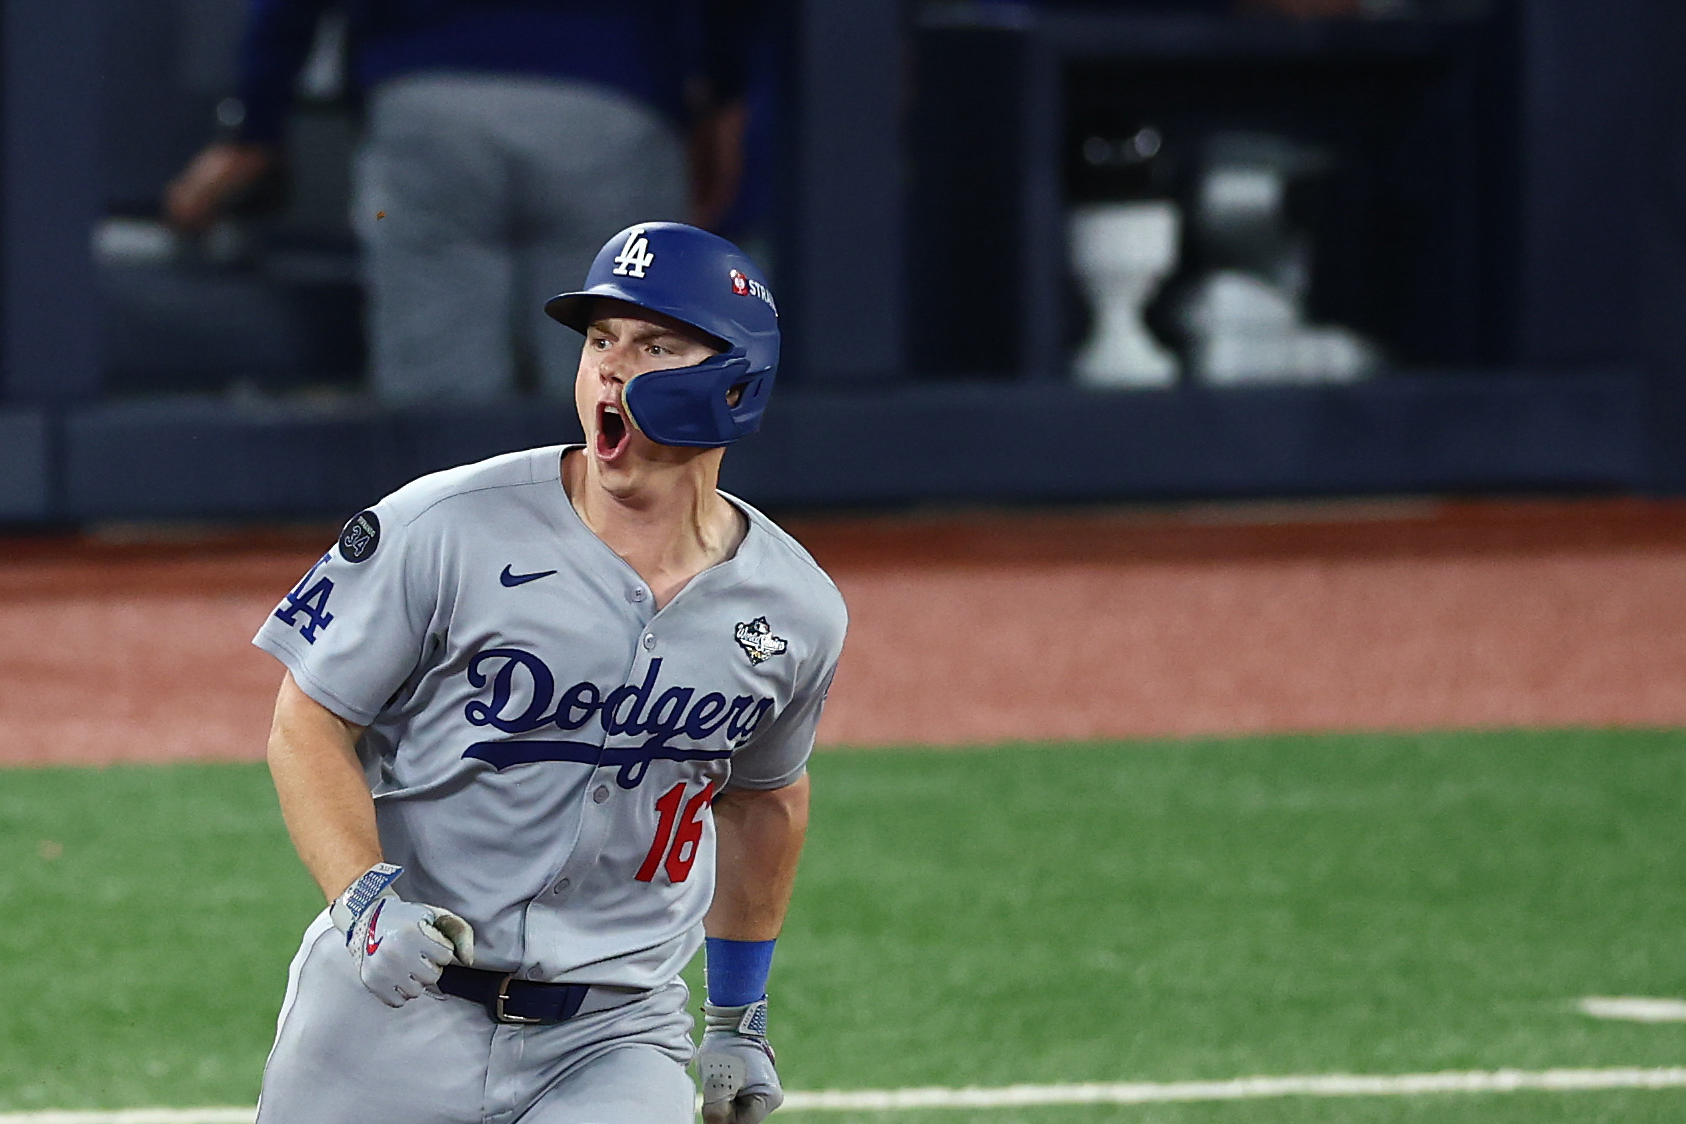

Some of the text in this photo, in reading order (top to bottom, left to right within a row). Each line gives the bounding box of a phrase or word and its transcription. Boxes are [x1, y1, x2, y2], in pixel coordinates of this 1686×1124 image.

[612, 229, 654, 278] LA
[344, 525, 370, 557] 34
[274, 553, 335, 646] LA
[464, 648, 775, 789] Dodgers
[634, 781, 713, 884] 16
